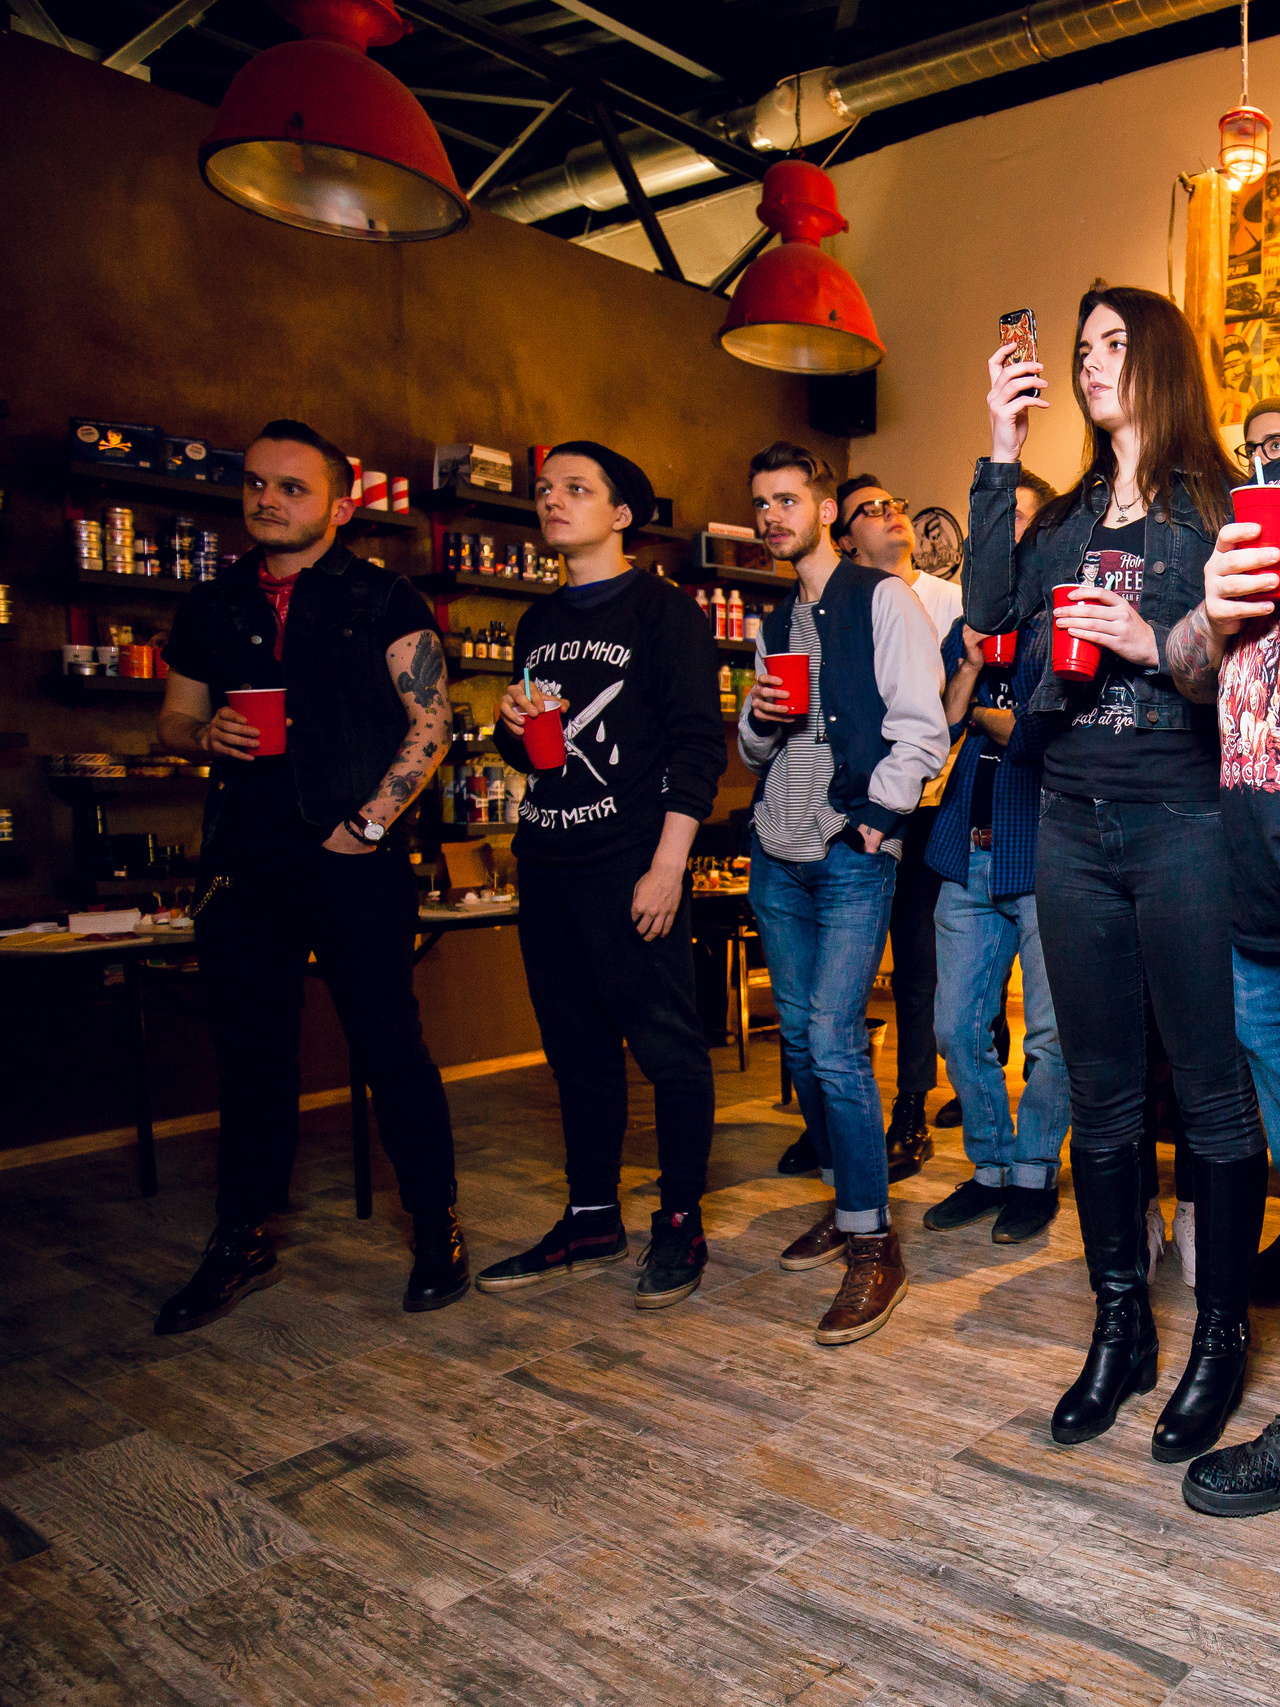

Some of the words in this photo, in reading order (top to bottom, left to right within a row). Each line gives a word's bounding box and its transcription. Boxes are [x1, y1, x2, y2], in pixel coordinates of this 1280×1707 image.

[560, 640, 581, 661] СО
[1098, 711, 1114, 726] at
[561, 796, 618, 830] МЕНЯ
